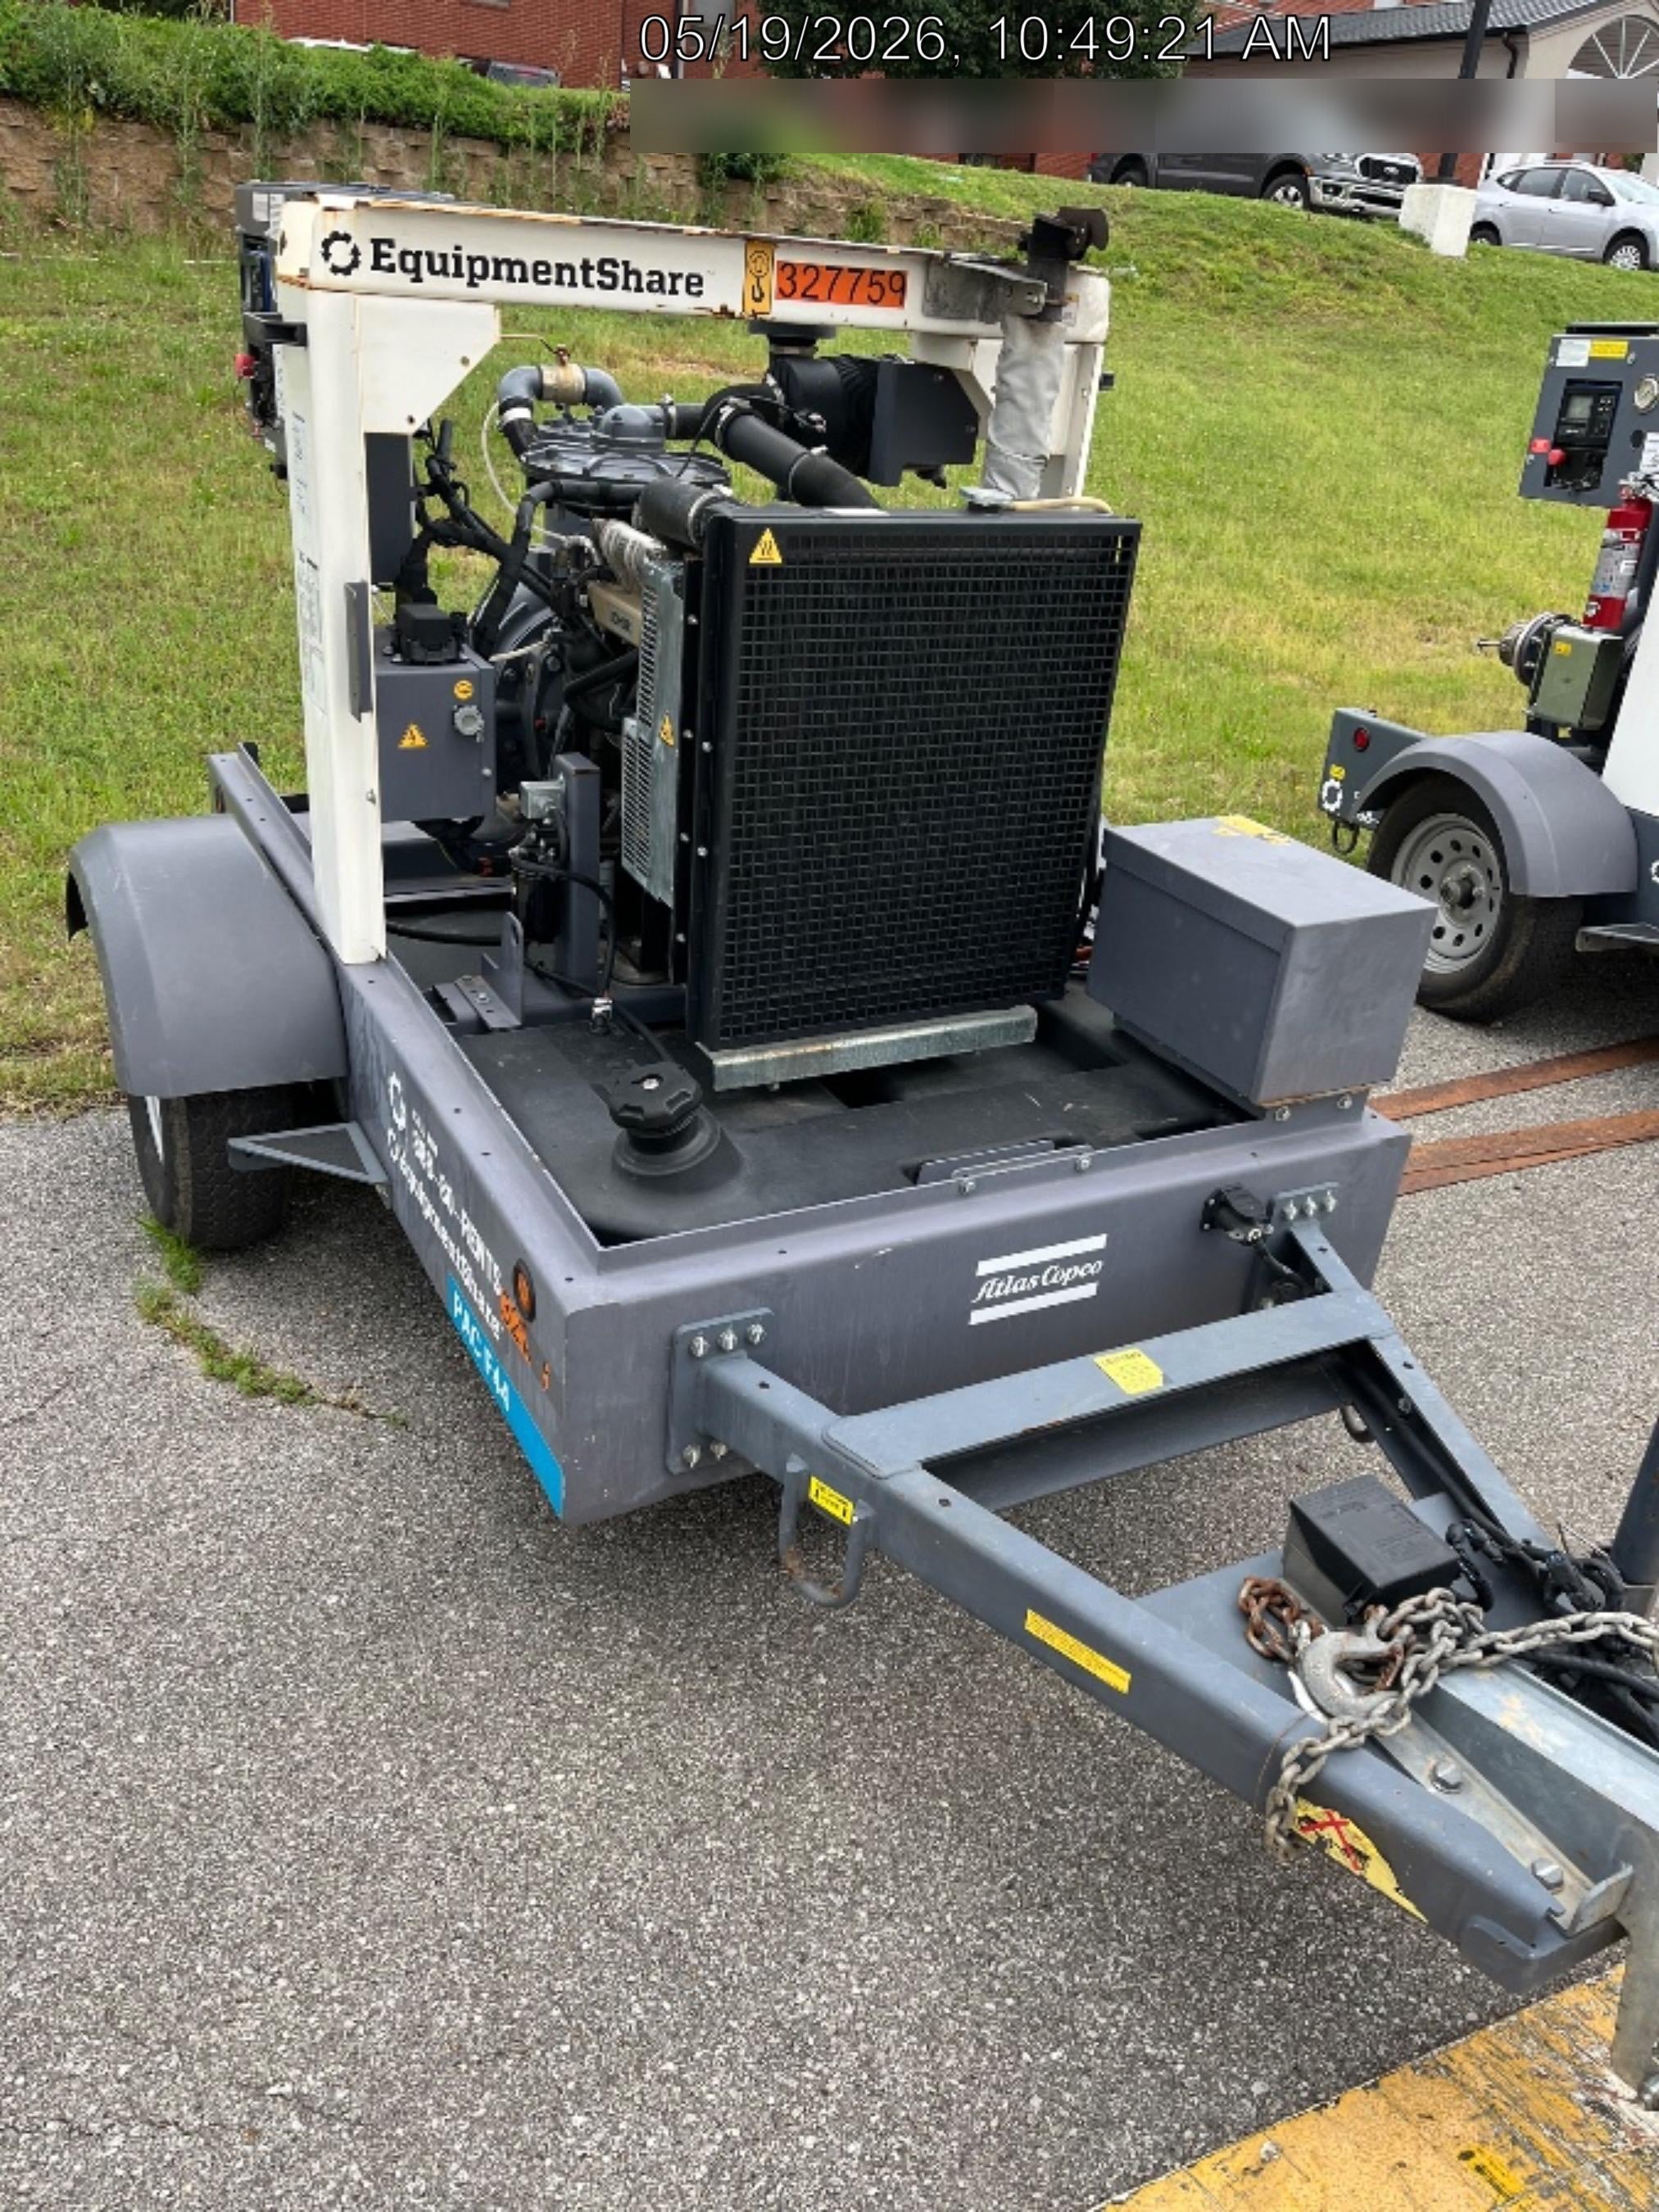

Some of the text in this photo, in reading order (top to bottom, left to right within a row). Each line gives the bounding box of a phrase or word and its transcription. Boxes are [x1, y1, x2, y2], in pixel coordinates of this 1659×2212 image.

[369, 237, 704, 297] EquipmentShare
[777, 262, 906, 307] 327759
[970, 1259, 1104, 1304] Atlas Copco
[453, 1290, 483, 1358] PAC
